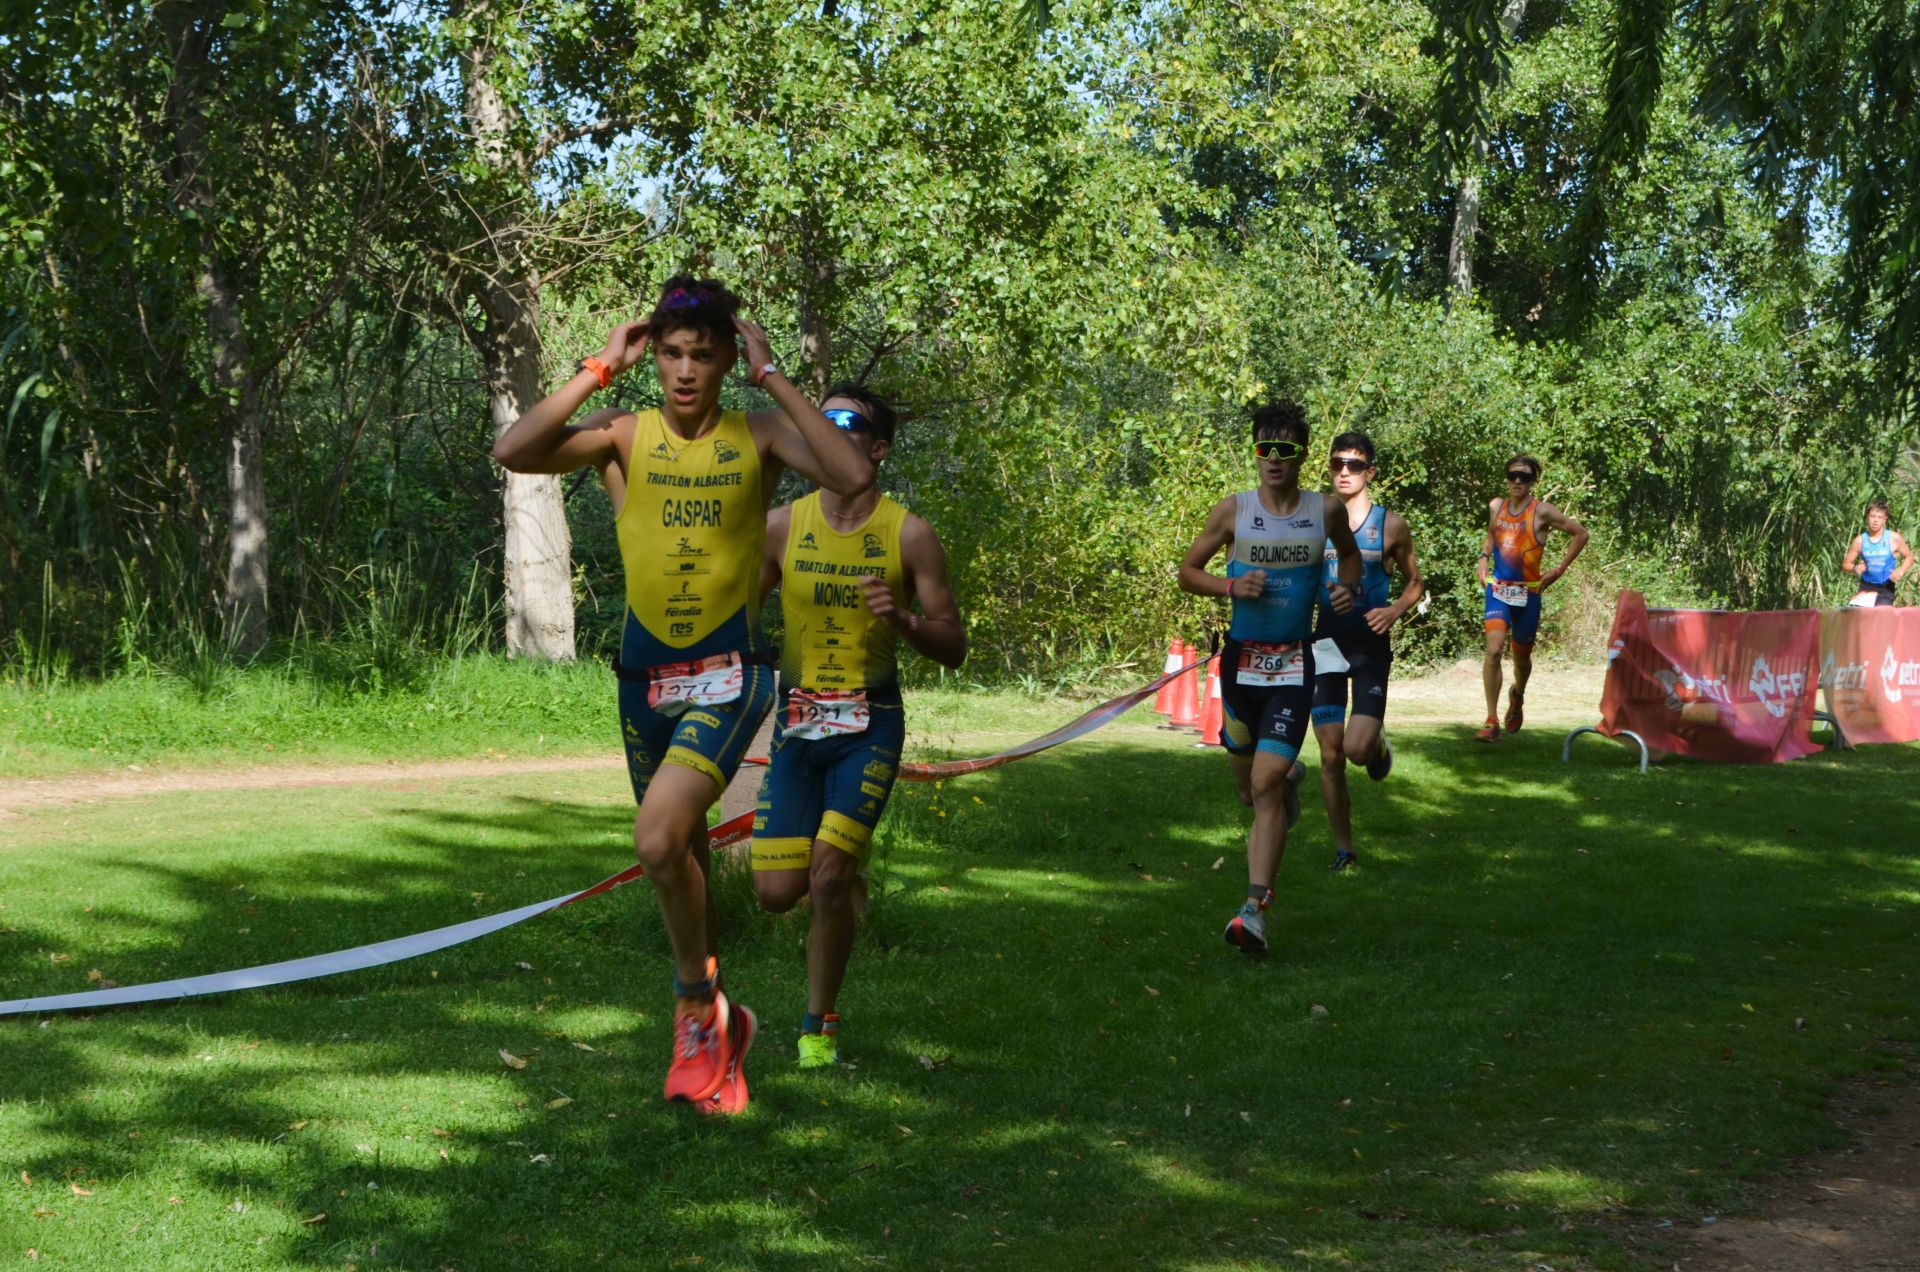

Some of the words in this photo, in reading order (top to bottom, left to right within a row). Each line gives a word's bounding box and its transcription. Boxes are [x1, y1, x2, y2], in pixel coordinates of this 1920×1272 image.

[647, 472, 691, 488] TRIATLÓN
[693, 472, 742, 488] ALBACETE
[662, 498, 722, 528] GASPAR
[1250, 545, 1309, 563] BOLINCHES
[794, 560, 838, 576] TRIATLÓN
[839, 564, 887, 580] ALBACETE
[814, 582, 859, 609] MONGE
